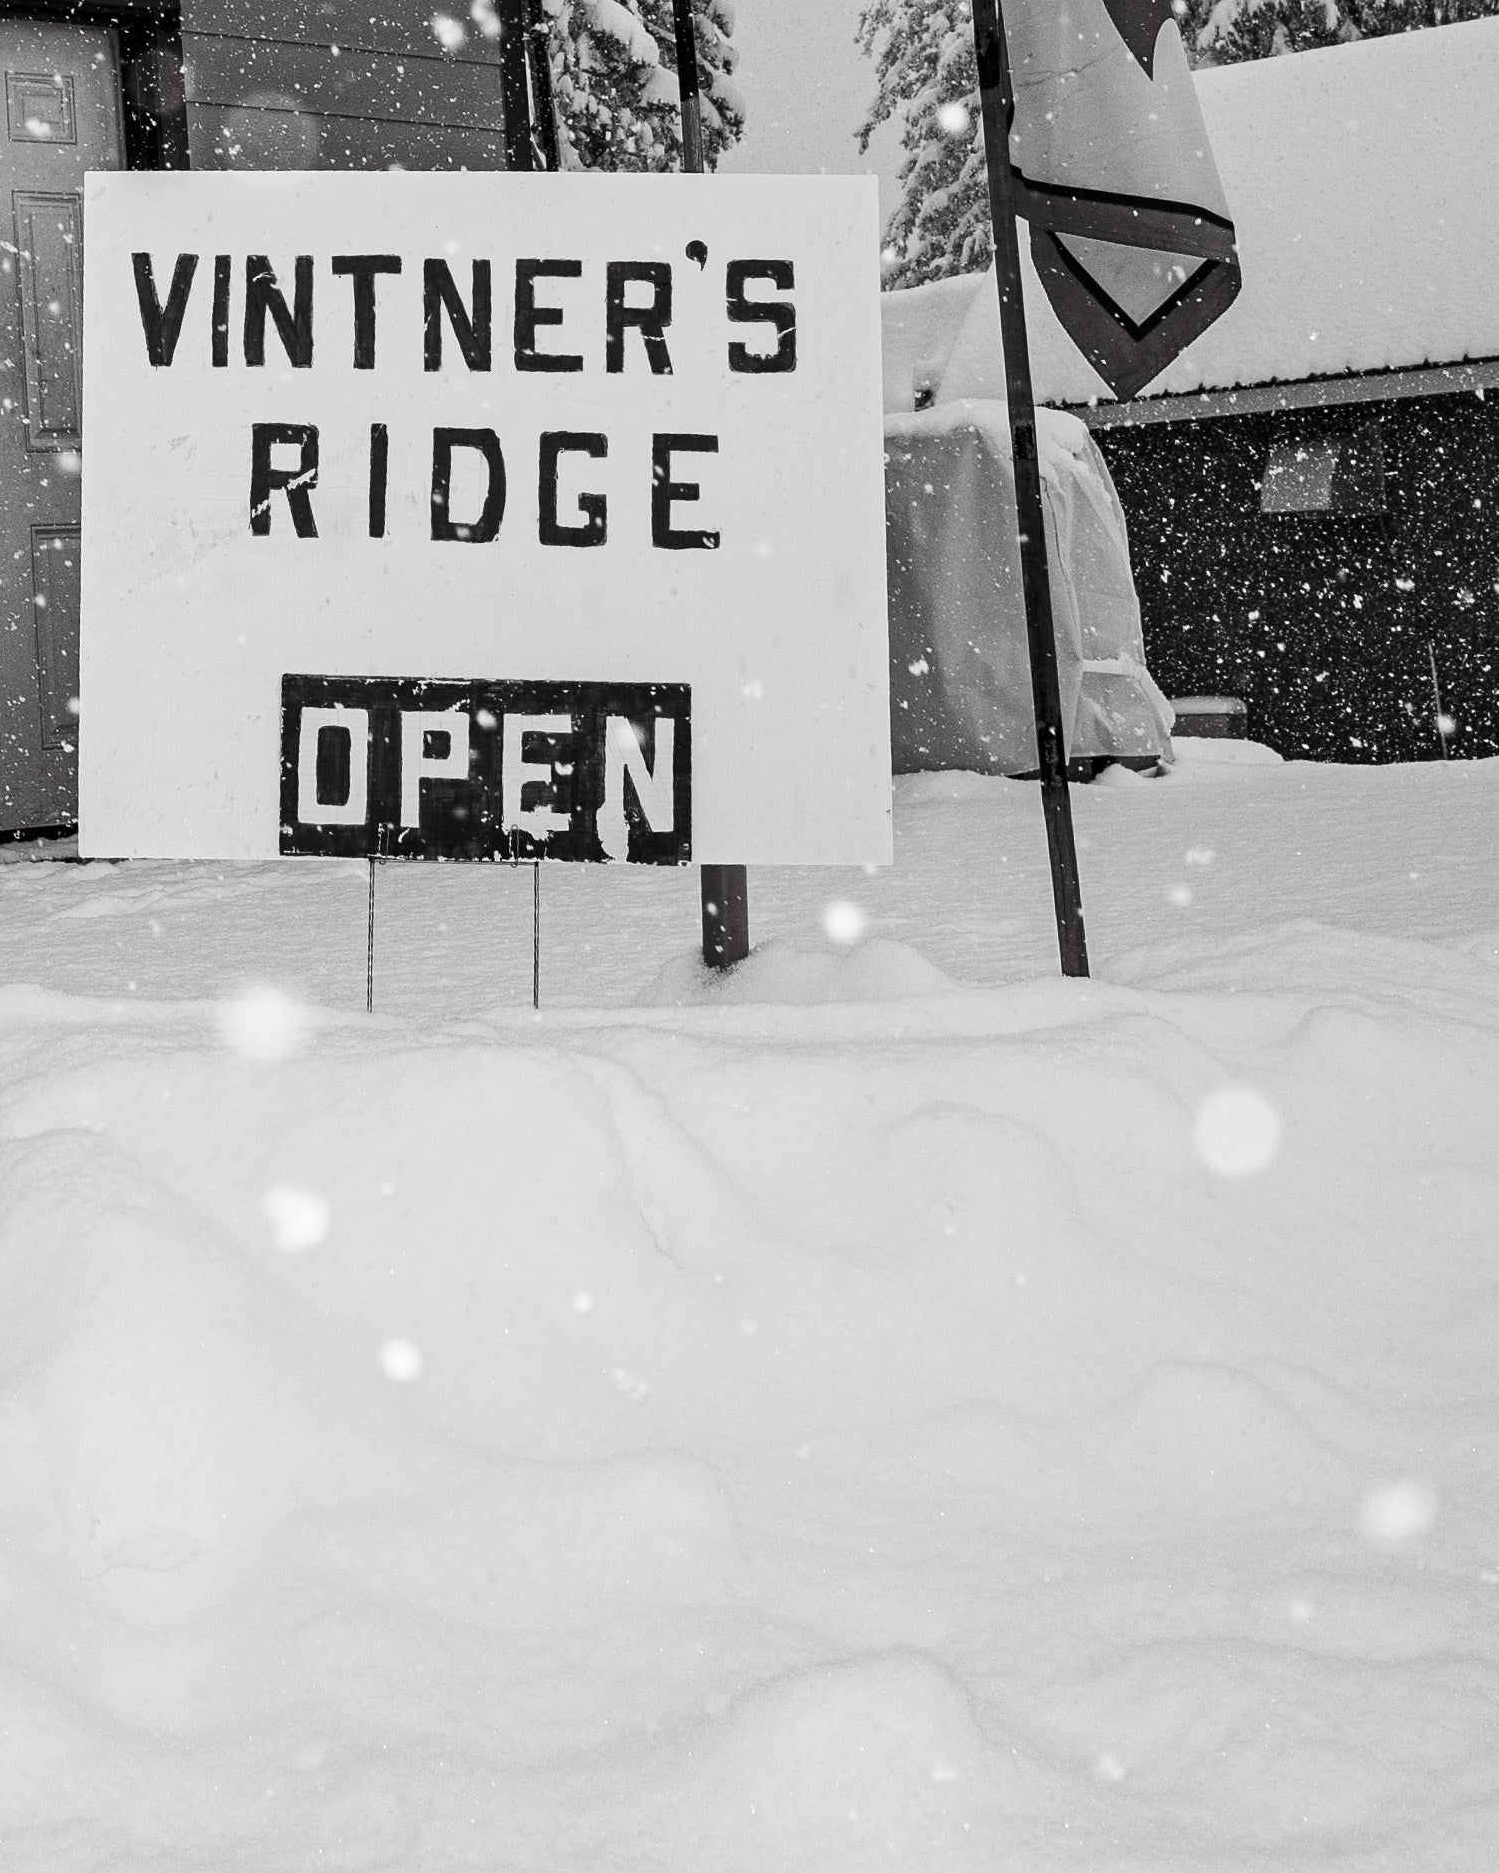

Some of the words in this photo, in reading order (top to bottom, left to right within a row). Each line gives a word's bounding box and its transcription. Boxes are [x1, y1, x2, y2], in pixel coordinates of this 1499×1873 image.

[131, 240, 799, 376] VINTNER'S
[249, 422, 722, 550] RIDGE
[297, 705, 675, 855] OPEN
